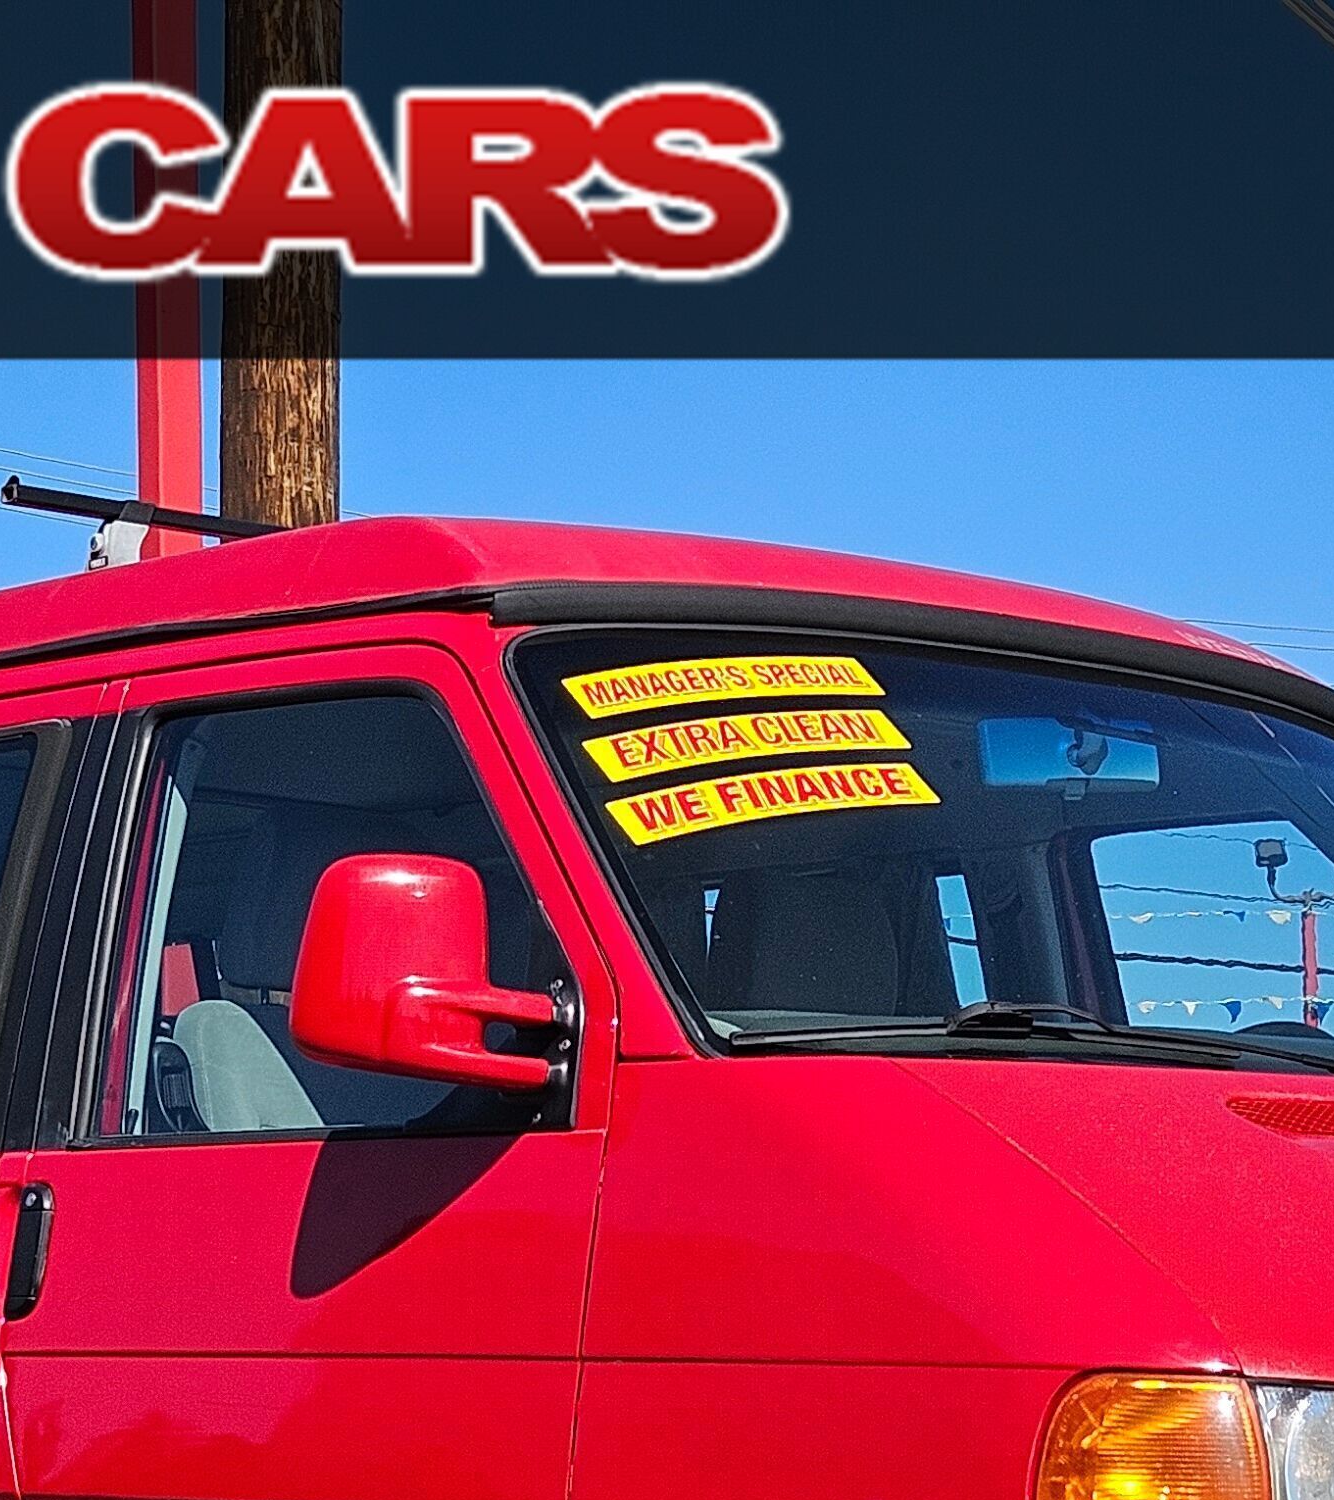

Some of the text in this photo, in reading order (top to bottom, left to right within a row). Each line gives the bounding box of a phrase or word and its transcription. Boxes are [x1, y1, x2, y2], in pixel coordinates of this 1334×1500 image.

[581, 663, 865, 706] MANAGER'S SPECIAL
[611, 713, 877, 768] EXTRA CLEAN
[630, 768, 912, 833] WE FINANCE
